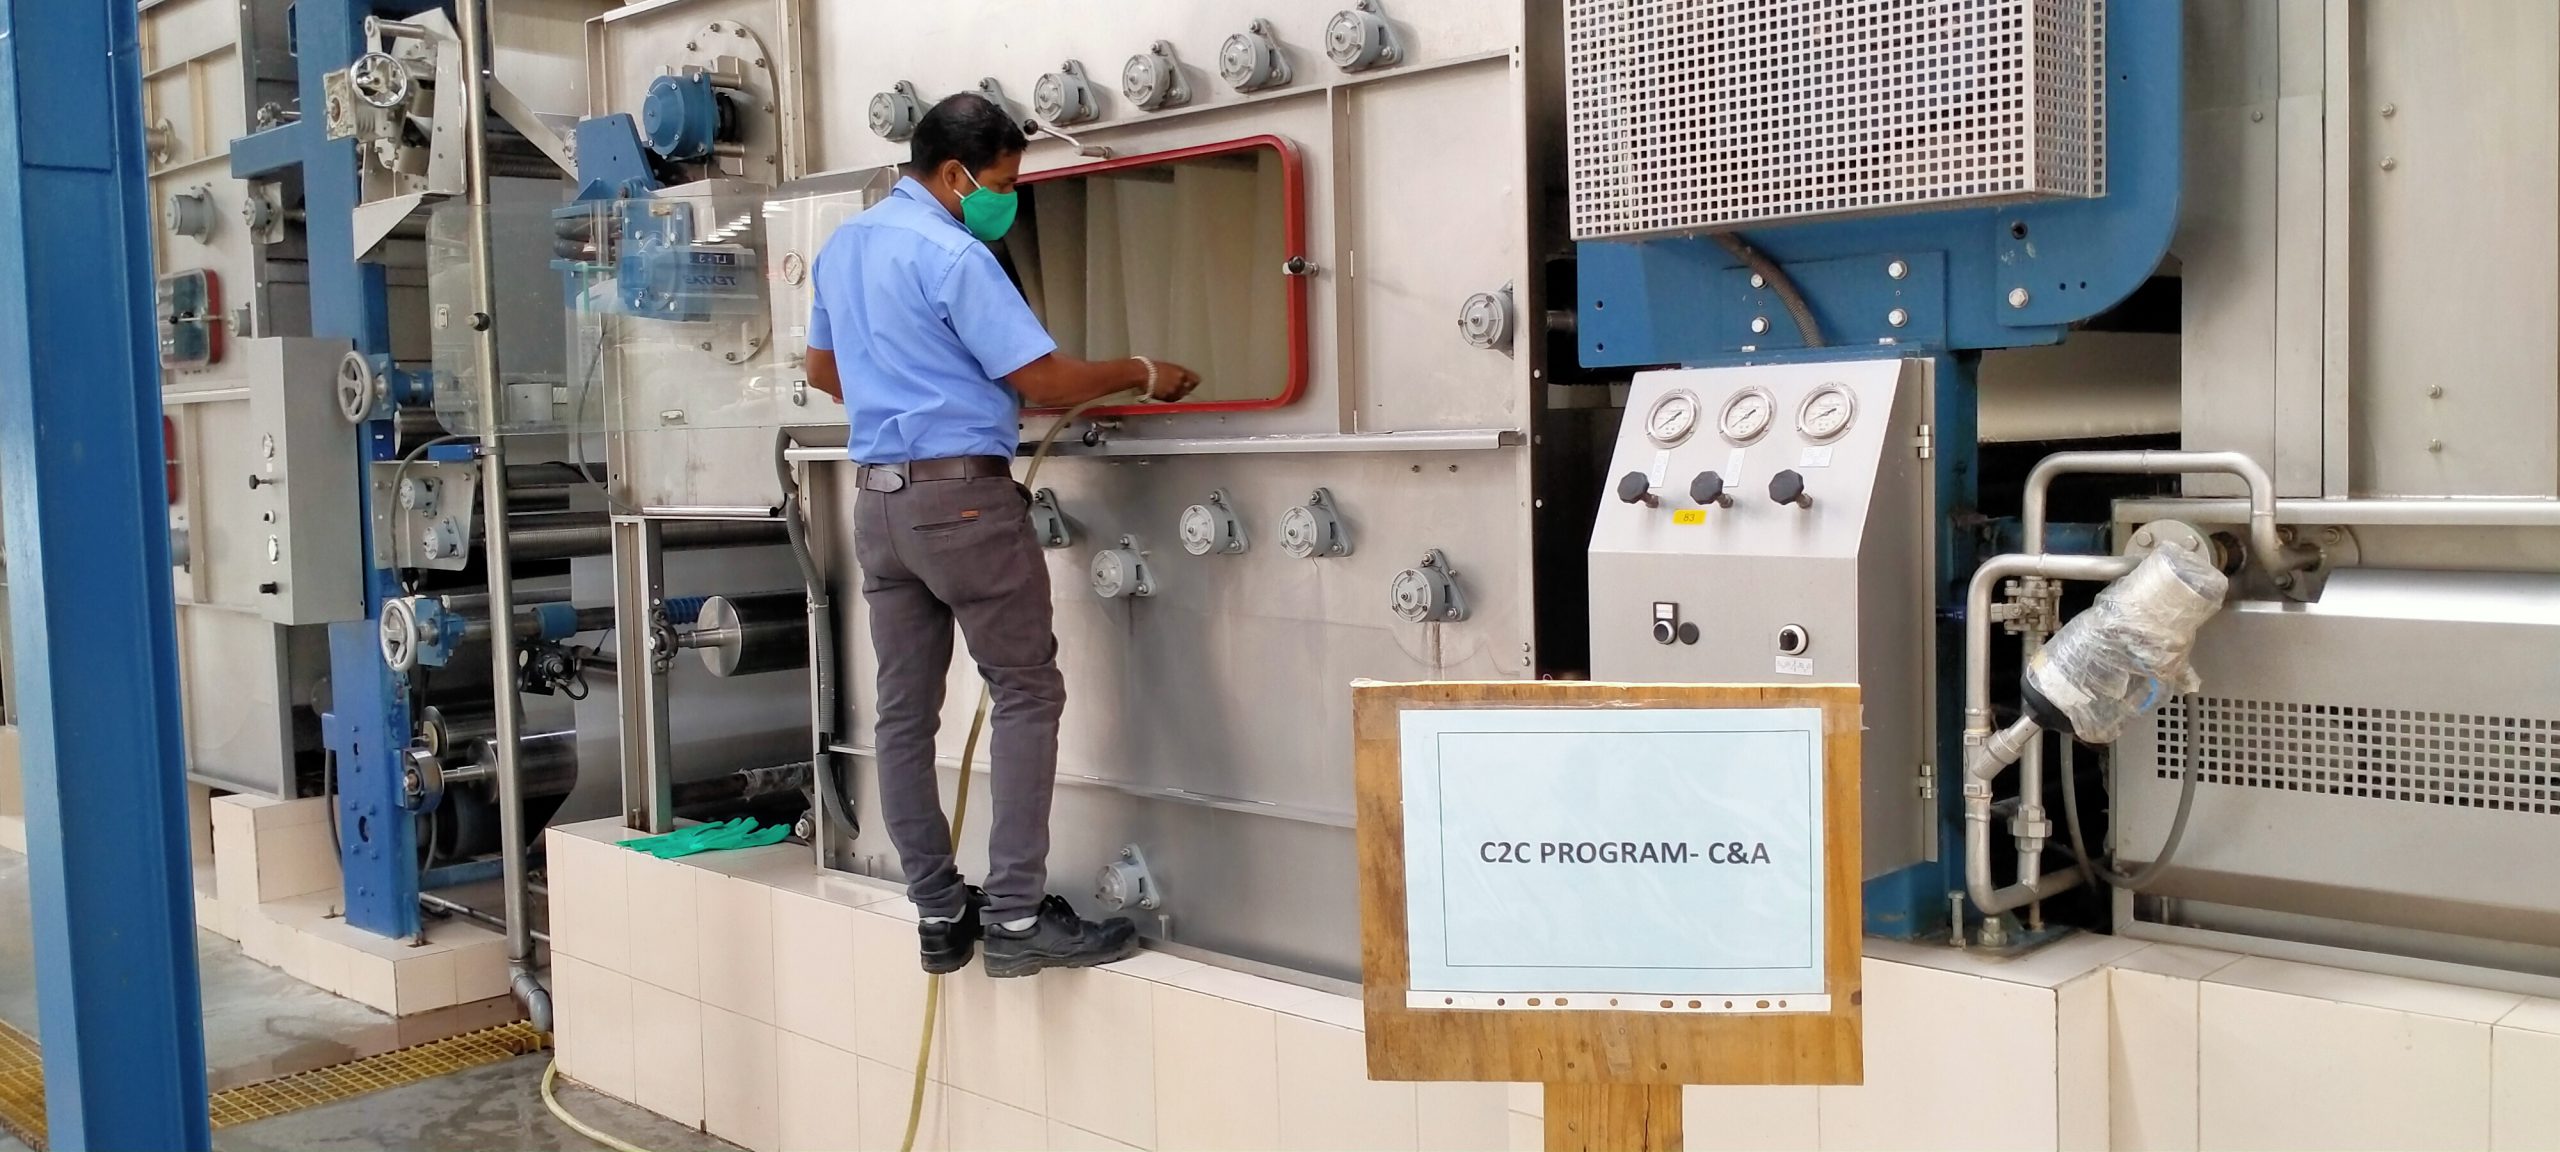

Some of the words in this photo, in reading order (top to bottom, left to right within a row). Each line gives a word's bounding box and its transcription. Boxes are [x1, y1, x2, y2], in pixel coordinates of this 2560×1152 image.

[1480, 841, 1531, 863] C2C
[1540, 841, 1699, 863] PROGRAM-
[1708, 841, 1771, 864] C&A
